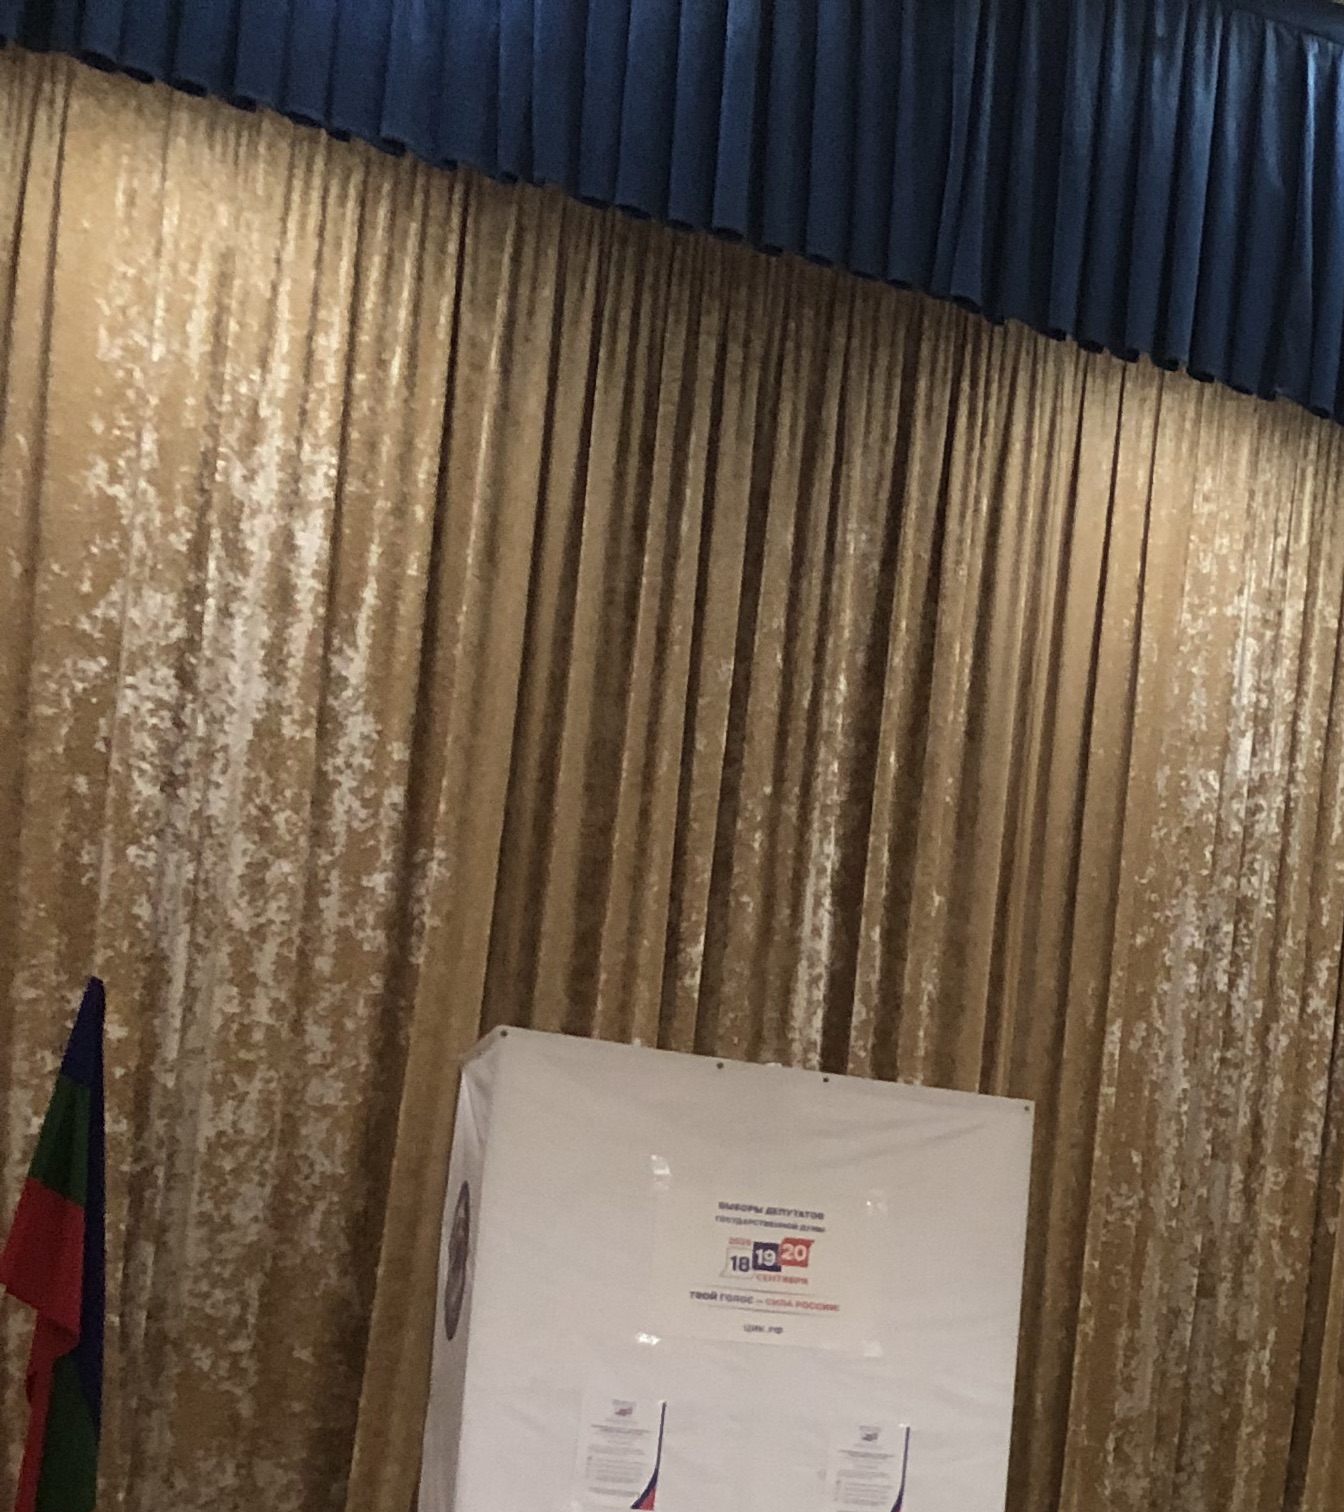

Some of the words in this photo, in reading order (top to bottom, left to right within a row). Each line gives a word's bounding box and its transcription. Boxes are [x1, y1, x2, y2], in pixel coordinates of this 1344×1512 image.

[718, 1201, 763, 1214] ВЫБОРЫ
[765, 1206, 824, 1220] ДЕПУТАТОВ
[730, 1255, 750, 1272] 18
[756, 1249, 776, 1266] 19
[781, 1244, 807, 1261] 20
[690, 1290, 717, 1301] ТВОЙ
